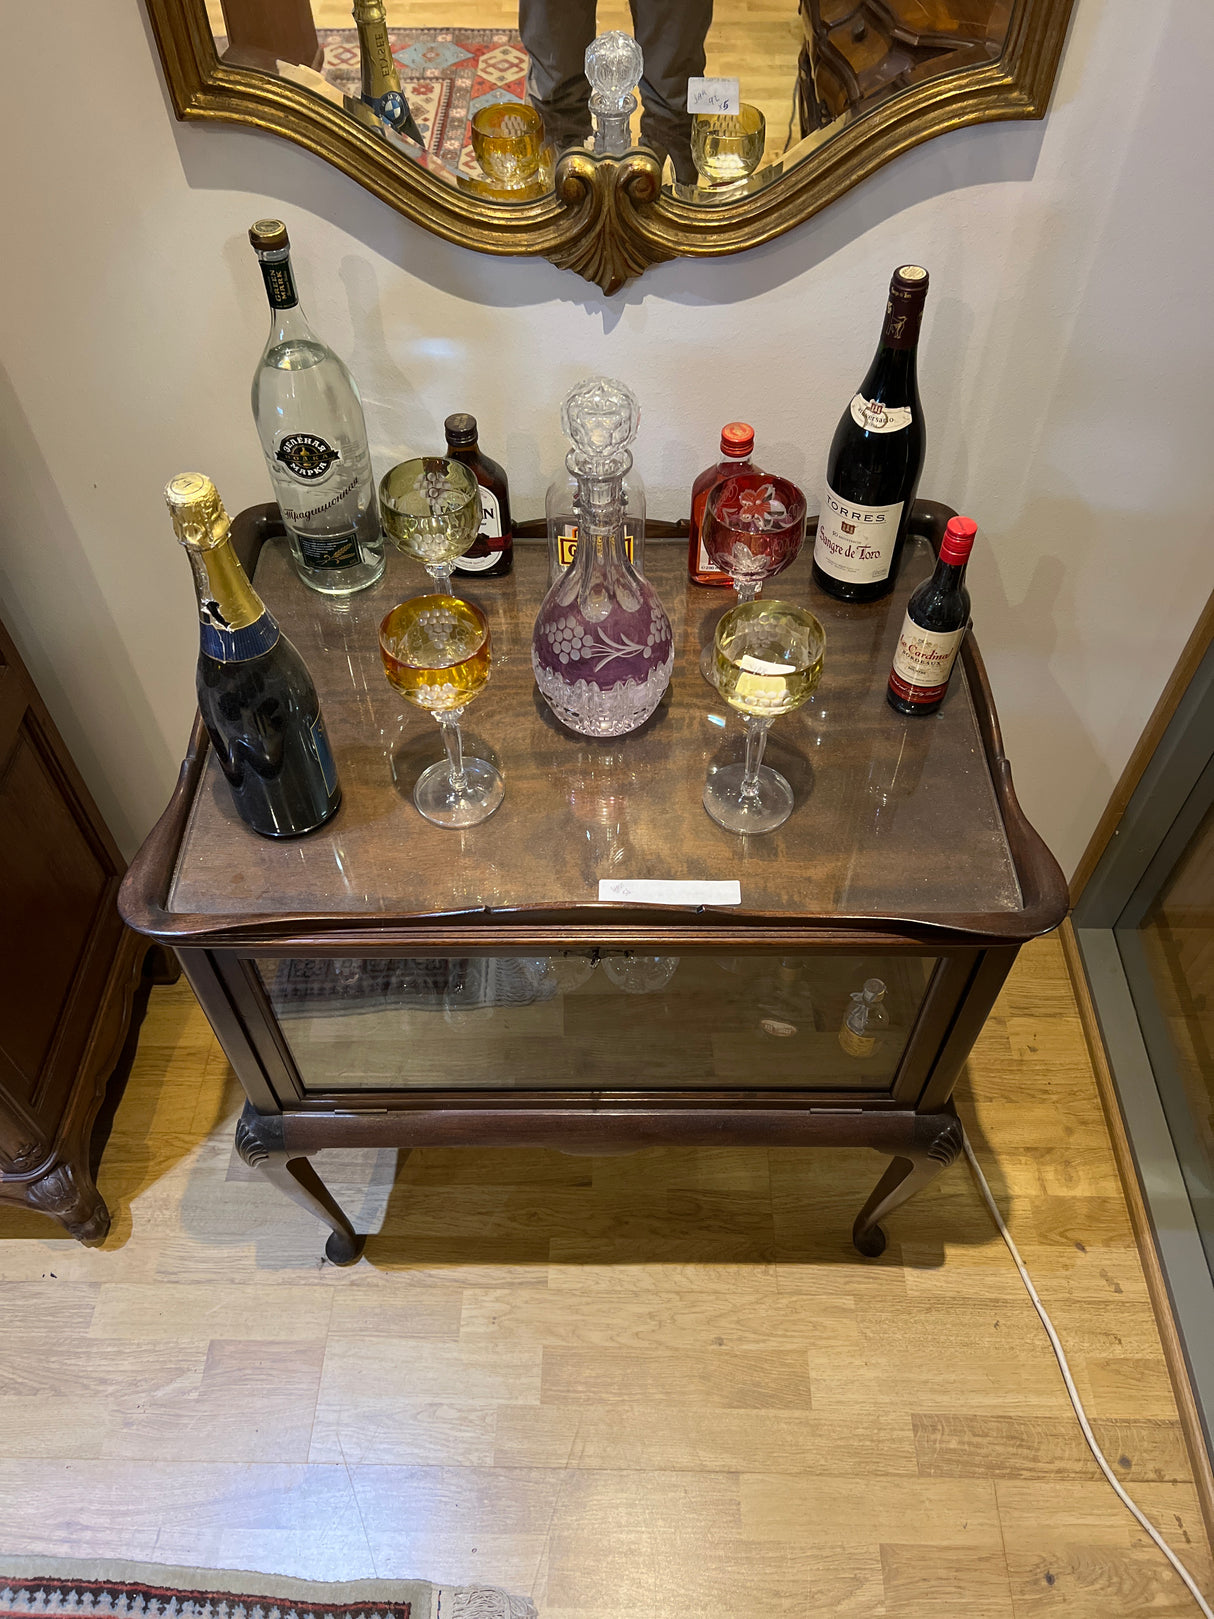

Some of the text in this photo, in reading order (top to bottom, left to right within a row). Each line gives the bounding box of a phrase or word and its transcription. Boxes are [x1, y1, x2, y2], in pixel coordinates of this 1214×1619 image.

[269, 269, 282, 302] GREEN
[276, 270, 288, 300] MARK
[857, 407, 894, 423] anersaro
[283, 436, 327, 453] ЗЕЛЁНАЯ
[289, 461, 328, 476] МАРКА
[826, 494, 886, 522] TORRES
[819, 525, 844, 555] Sangre
[844, 544, 855, 559] de
[856, 544, 881, 560] Toro
[902, 649, 941, 666] BORDEAUX
[908, 644, 953, 660] Cardinal
